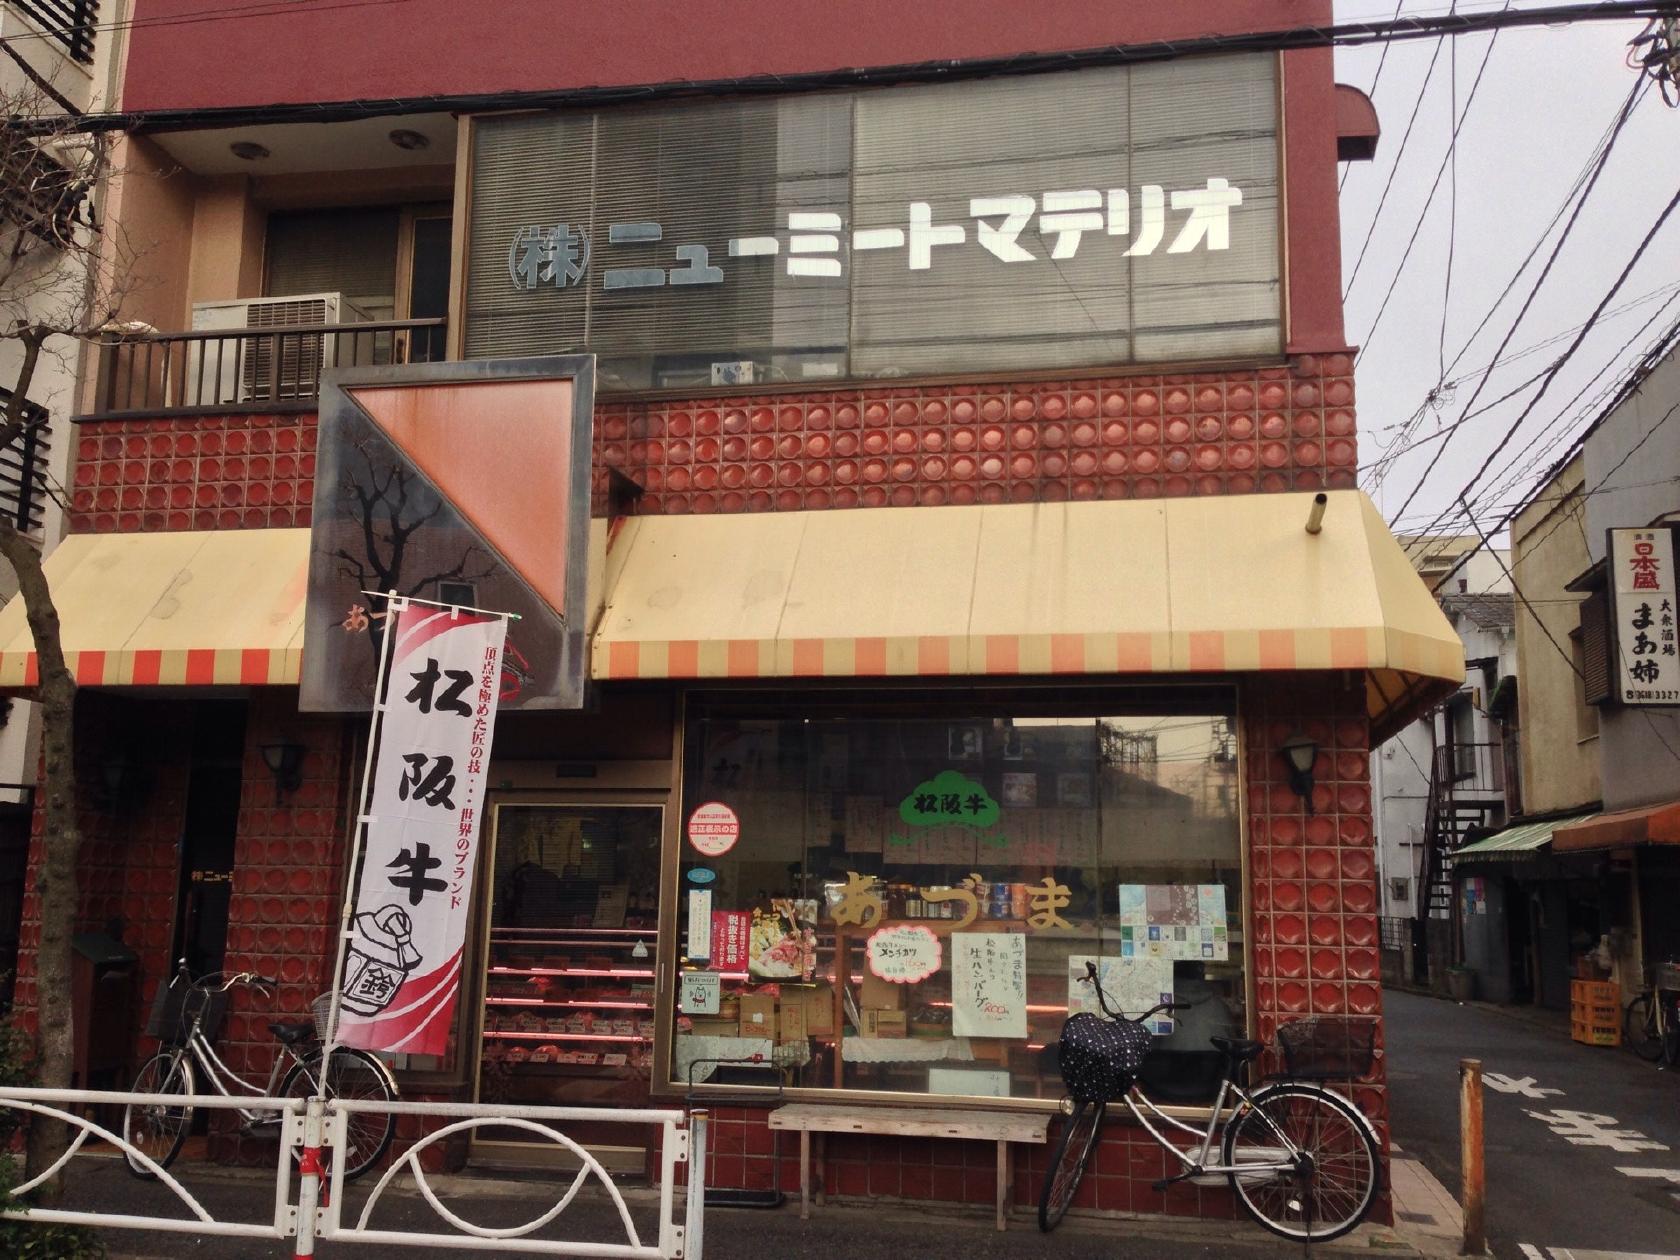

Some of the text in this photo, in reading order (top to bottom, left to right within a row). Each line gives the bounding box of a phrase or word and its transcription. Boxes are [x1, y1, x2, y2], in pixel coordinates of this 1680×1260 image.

[1629, 543, 1660, 590] 日本盛
[1629, 602, 1660, 684] まあ姉
[1660, 599, 1676, 656] 大衆酒場
[385, 657, 474, 906] 松阪牛
[913, 793, 989, 816] 松阪牛
[830, 871, 1075, 930] あづま
[879, 948, 917, 958] メンチカツ
